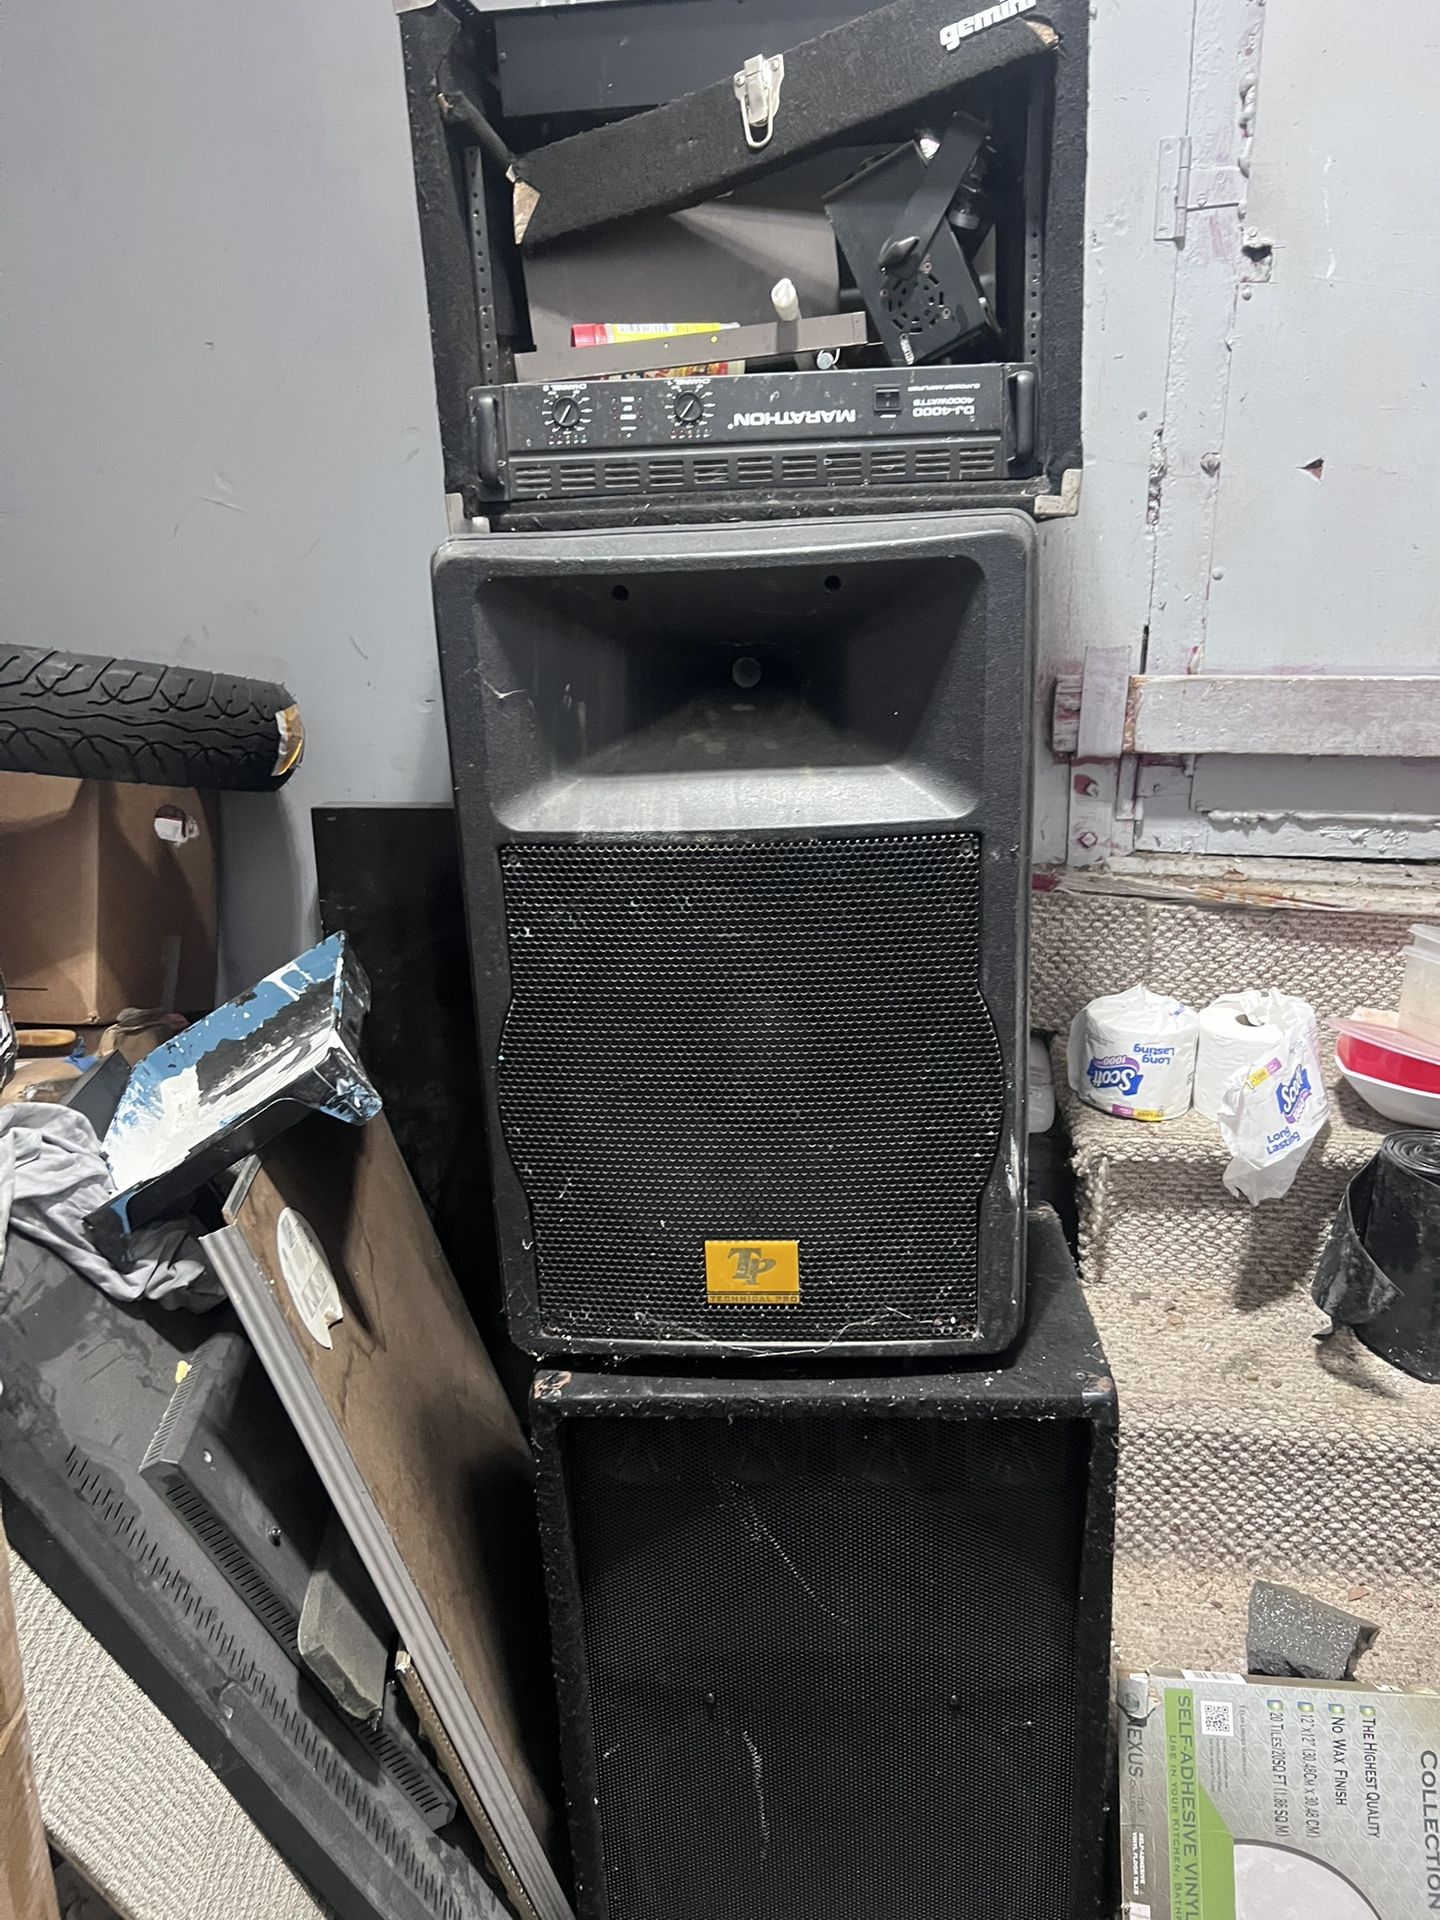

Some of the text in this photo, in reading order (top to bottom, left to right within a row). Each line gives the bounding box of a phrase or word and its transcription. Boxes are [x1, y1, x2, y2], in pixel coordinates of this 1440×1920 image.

[733, 409, 857, 428] MARATHON
[912, 405, 976, 418] DJ-4000
[1132, 1043, 1175, 1056] Lasting
[1103, 1055, 1127, 1066] 1000
[1141, 1054, 1171, 1065] Long
[1092, 1068, 1136, 1091] Scott
[1266, 1126, 1292, 1144] Long
[1266, 1131, 1301, 1155] Lasting
[1270, 1712, 1283, 1723] 20
[1169, 1735, 1177, 1760] USE
[1333, 1738, 1347, 1764] WAX
[1170, 1763, 1177, 1777] IN
[1362, 1718, 1381, 1838] THE HIGHEST QUALITY
[1273, 1774, 1287, 1786] FT
[1334, 1770, 1348, 1806] FINISH
[1170, 1781, 1179, 1814] YOUR
[1178, 1695, 1200, 1920] SELF-ADHESIVE VINYL
[1275, 1809, 1288, 1823] SQ
[1420, 1750, 1440, 1910] COLLECTION
